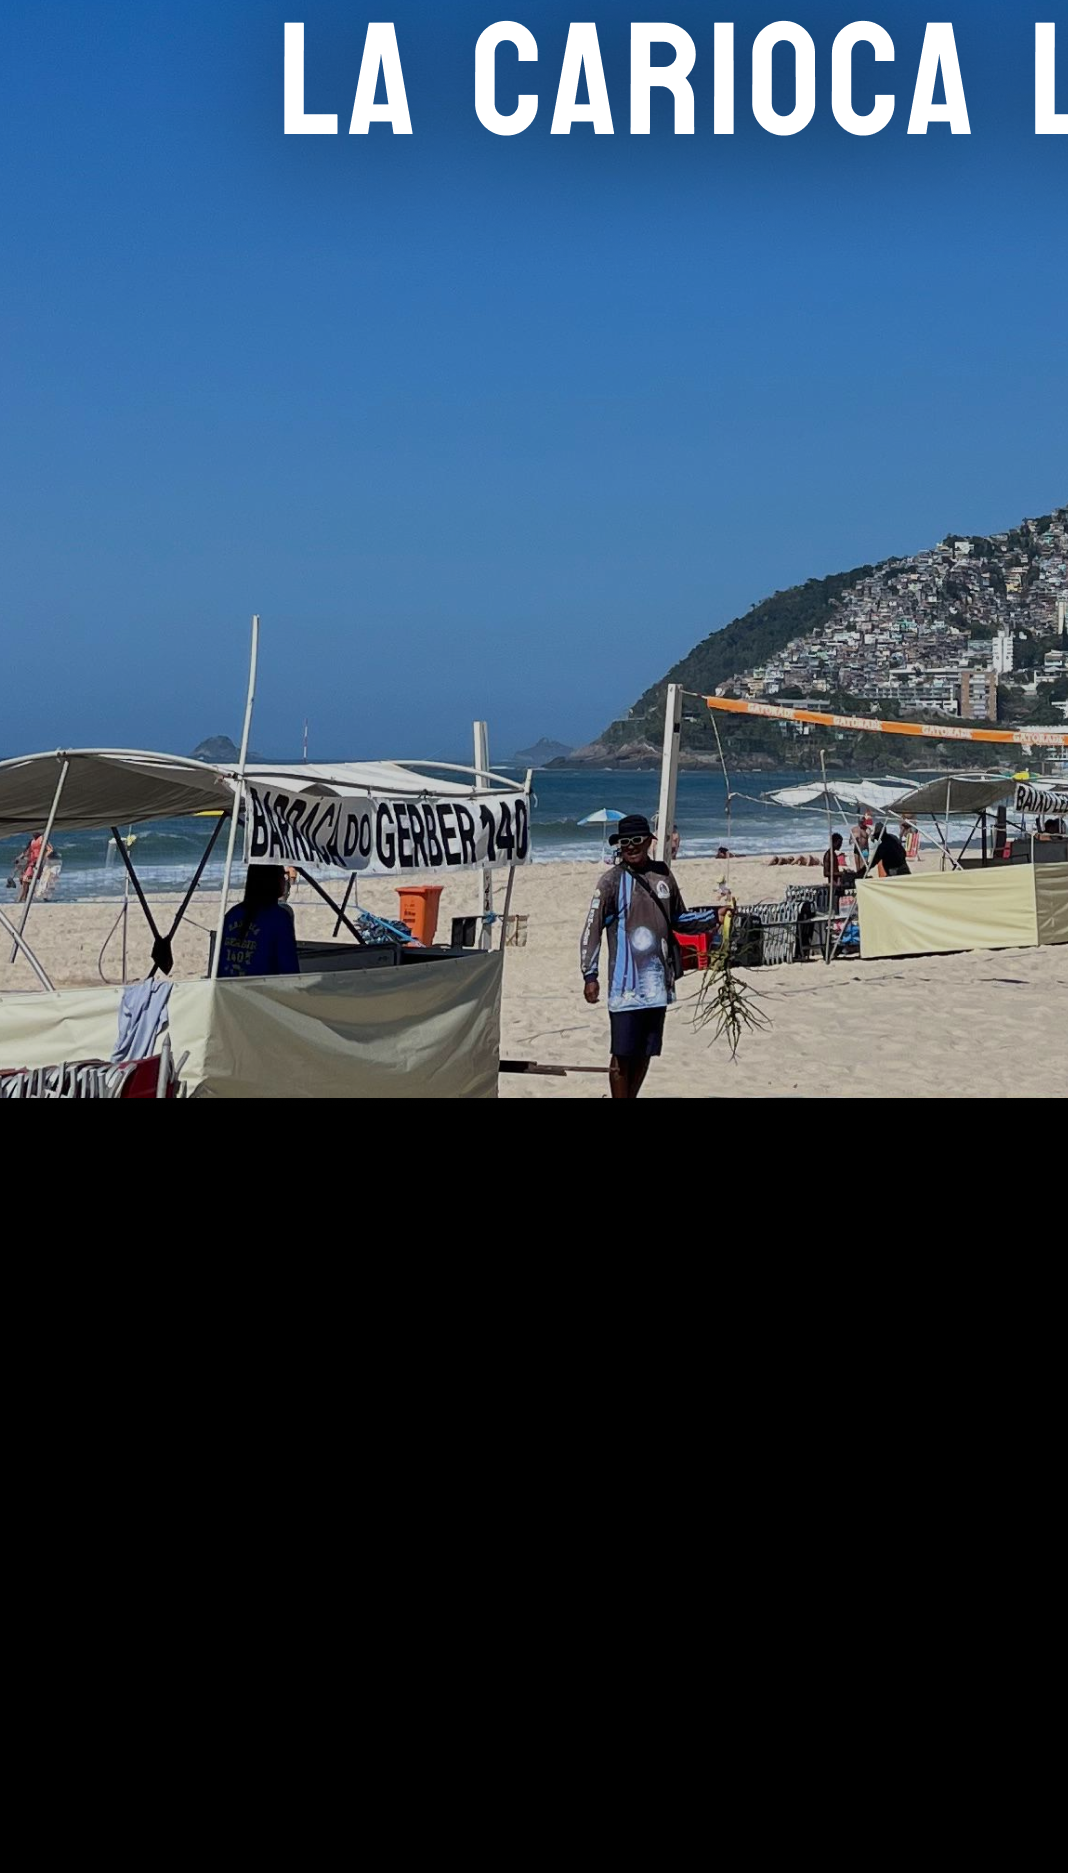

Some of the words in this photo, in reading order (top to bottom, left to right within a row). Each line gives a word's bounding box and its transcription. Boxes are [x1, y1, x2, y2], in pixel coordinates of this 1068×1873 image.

[250, 787, 347, 867] BARRACA
[344, 814, 371, 857] DO
[376, 802, 476, 869] GERBER
[479, 798, 528, 862] 140
